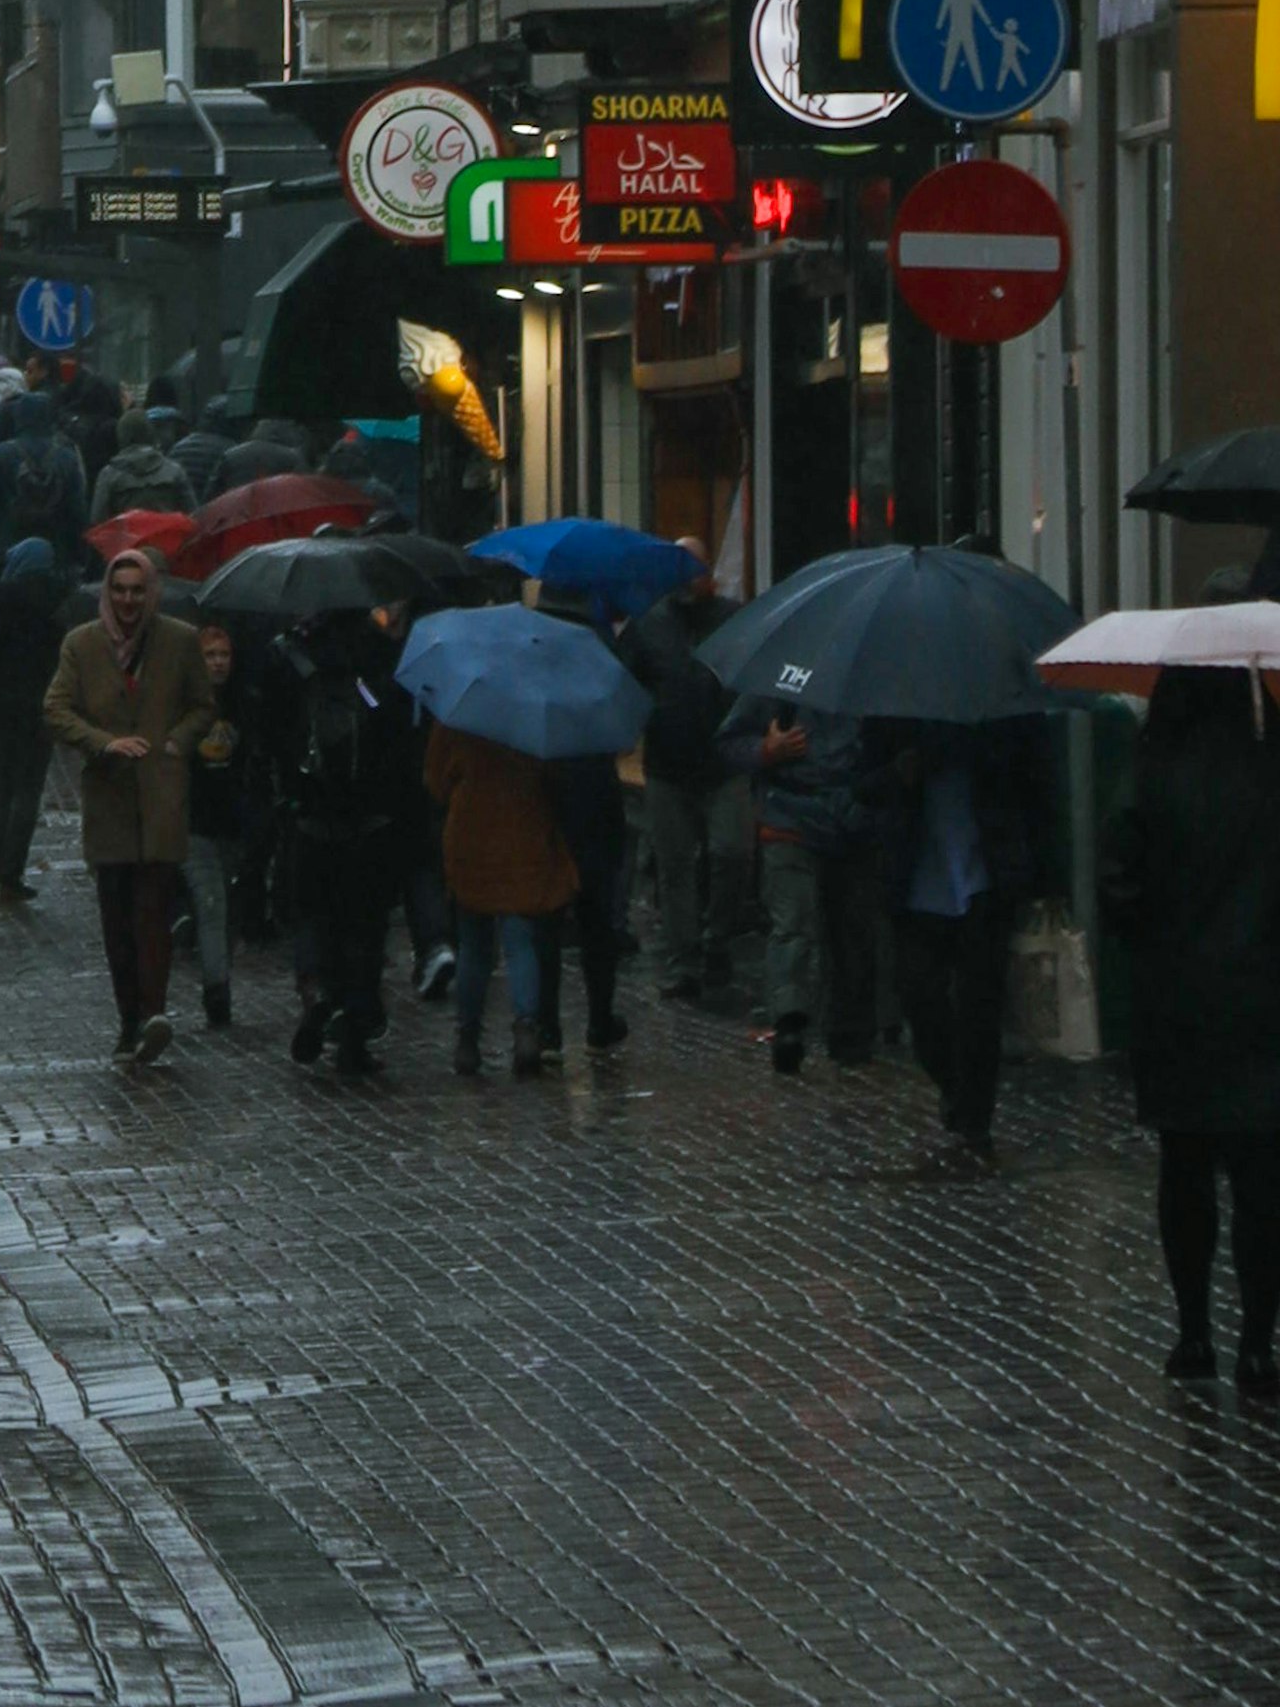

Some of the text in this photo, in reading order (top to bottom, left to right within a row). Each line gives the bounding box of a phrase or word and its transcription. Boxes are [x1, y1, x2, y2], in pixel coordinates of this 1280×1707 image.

[591, 93, 728, 121] SHOARMA
[381, 122, 467, 169] D&G
[619, 173, 704, 195] HALAL
[619, 207, 704, 235] PIZZA
